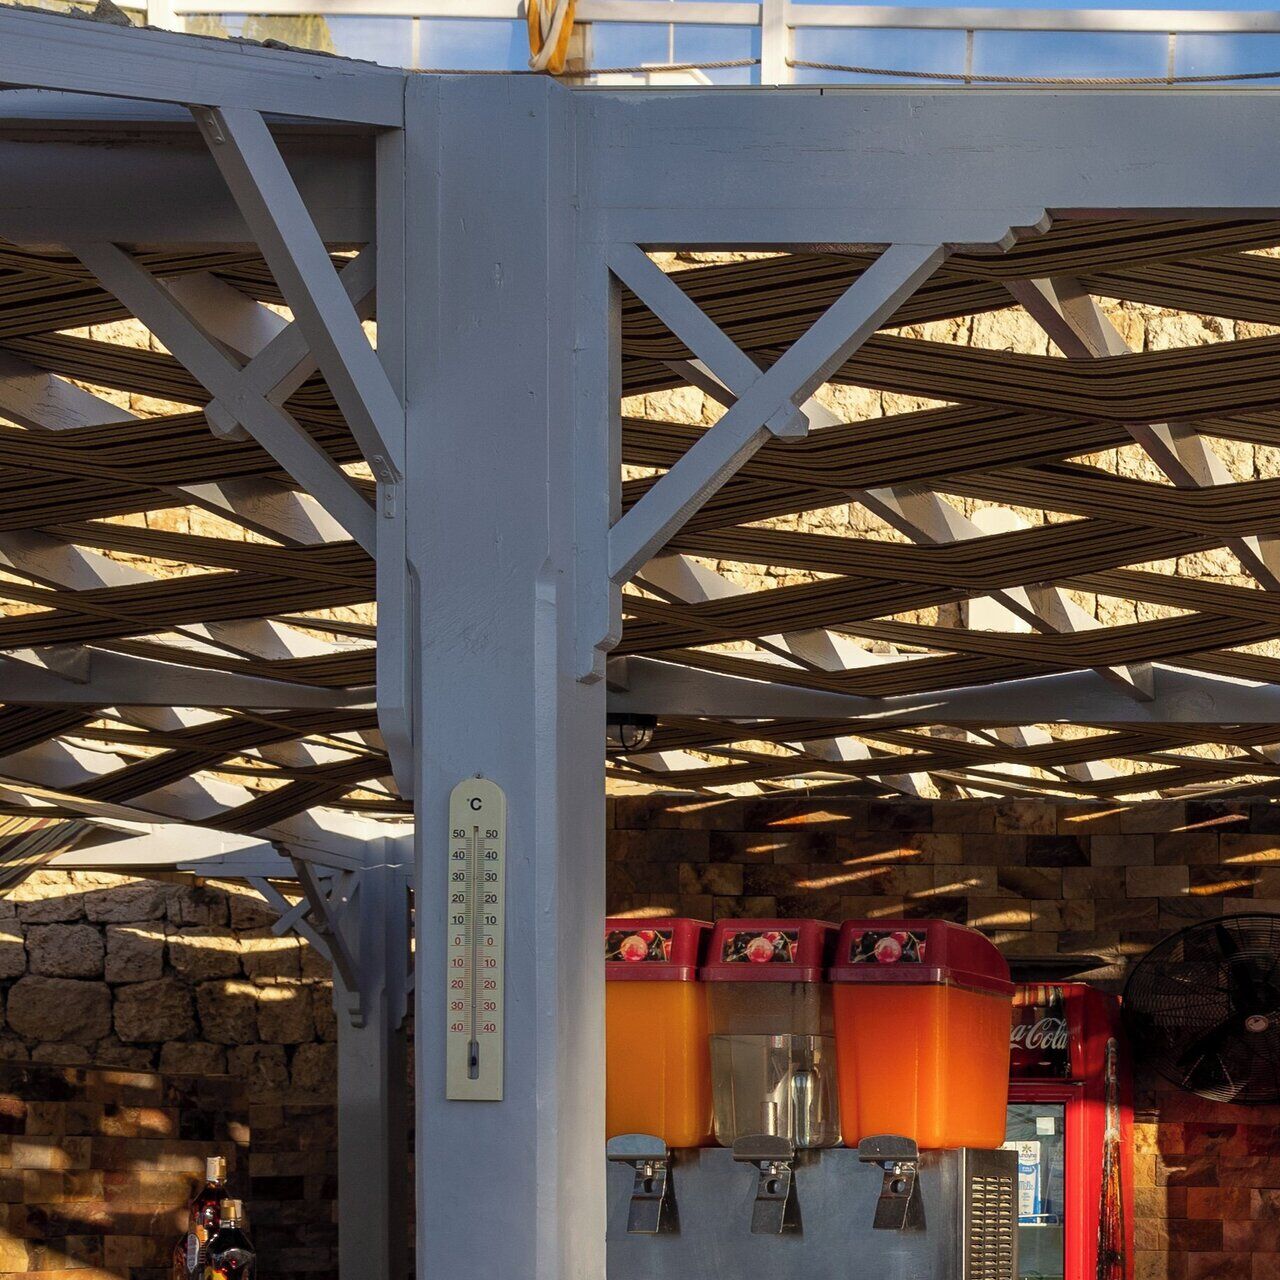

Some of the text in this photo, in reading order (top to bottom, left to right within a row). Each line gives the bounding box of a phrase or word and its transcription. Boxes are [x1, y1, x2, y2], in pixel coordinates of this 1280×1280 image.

[453, 829, 465, 838] 50
[485, 829, 498, 838] 50
[452, 851, 465, 860] 40
[485, 851, 498, 860] 40
[452, 872, 465, 881] 30
[485, 873, 498, 881] 30
[452, 894, 465, 903] 20
[485, 894, 497, 903] 20
[452, 915, 464, 924] 10
[485, 916, 497, 924] 10
[455, 937, 461, 946] 0
[487, 937, 494, 946] 0
[452, 958, 464, 967] 10
[485, 959, 496, 967] 10
[451, 980, 464, 989] 20
[484, 980, 496, 989] 20
[451, 1002, 464, 1011] 30
[484, 1002, 496, 1011] 30
[451, 1023, 464, 1032] 40
[484, 1023, 496, 1032] 40
[1010, 1017, 1068, 1050] a-Cola
